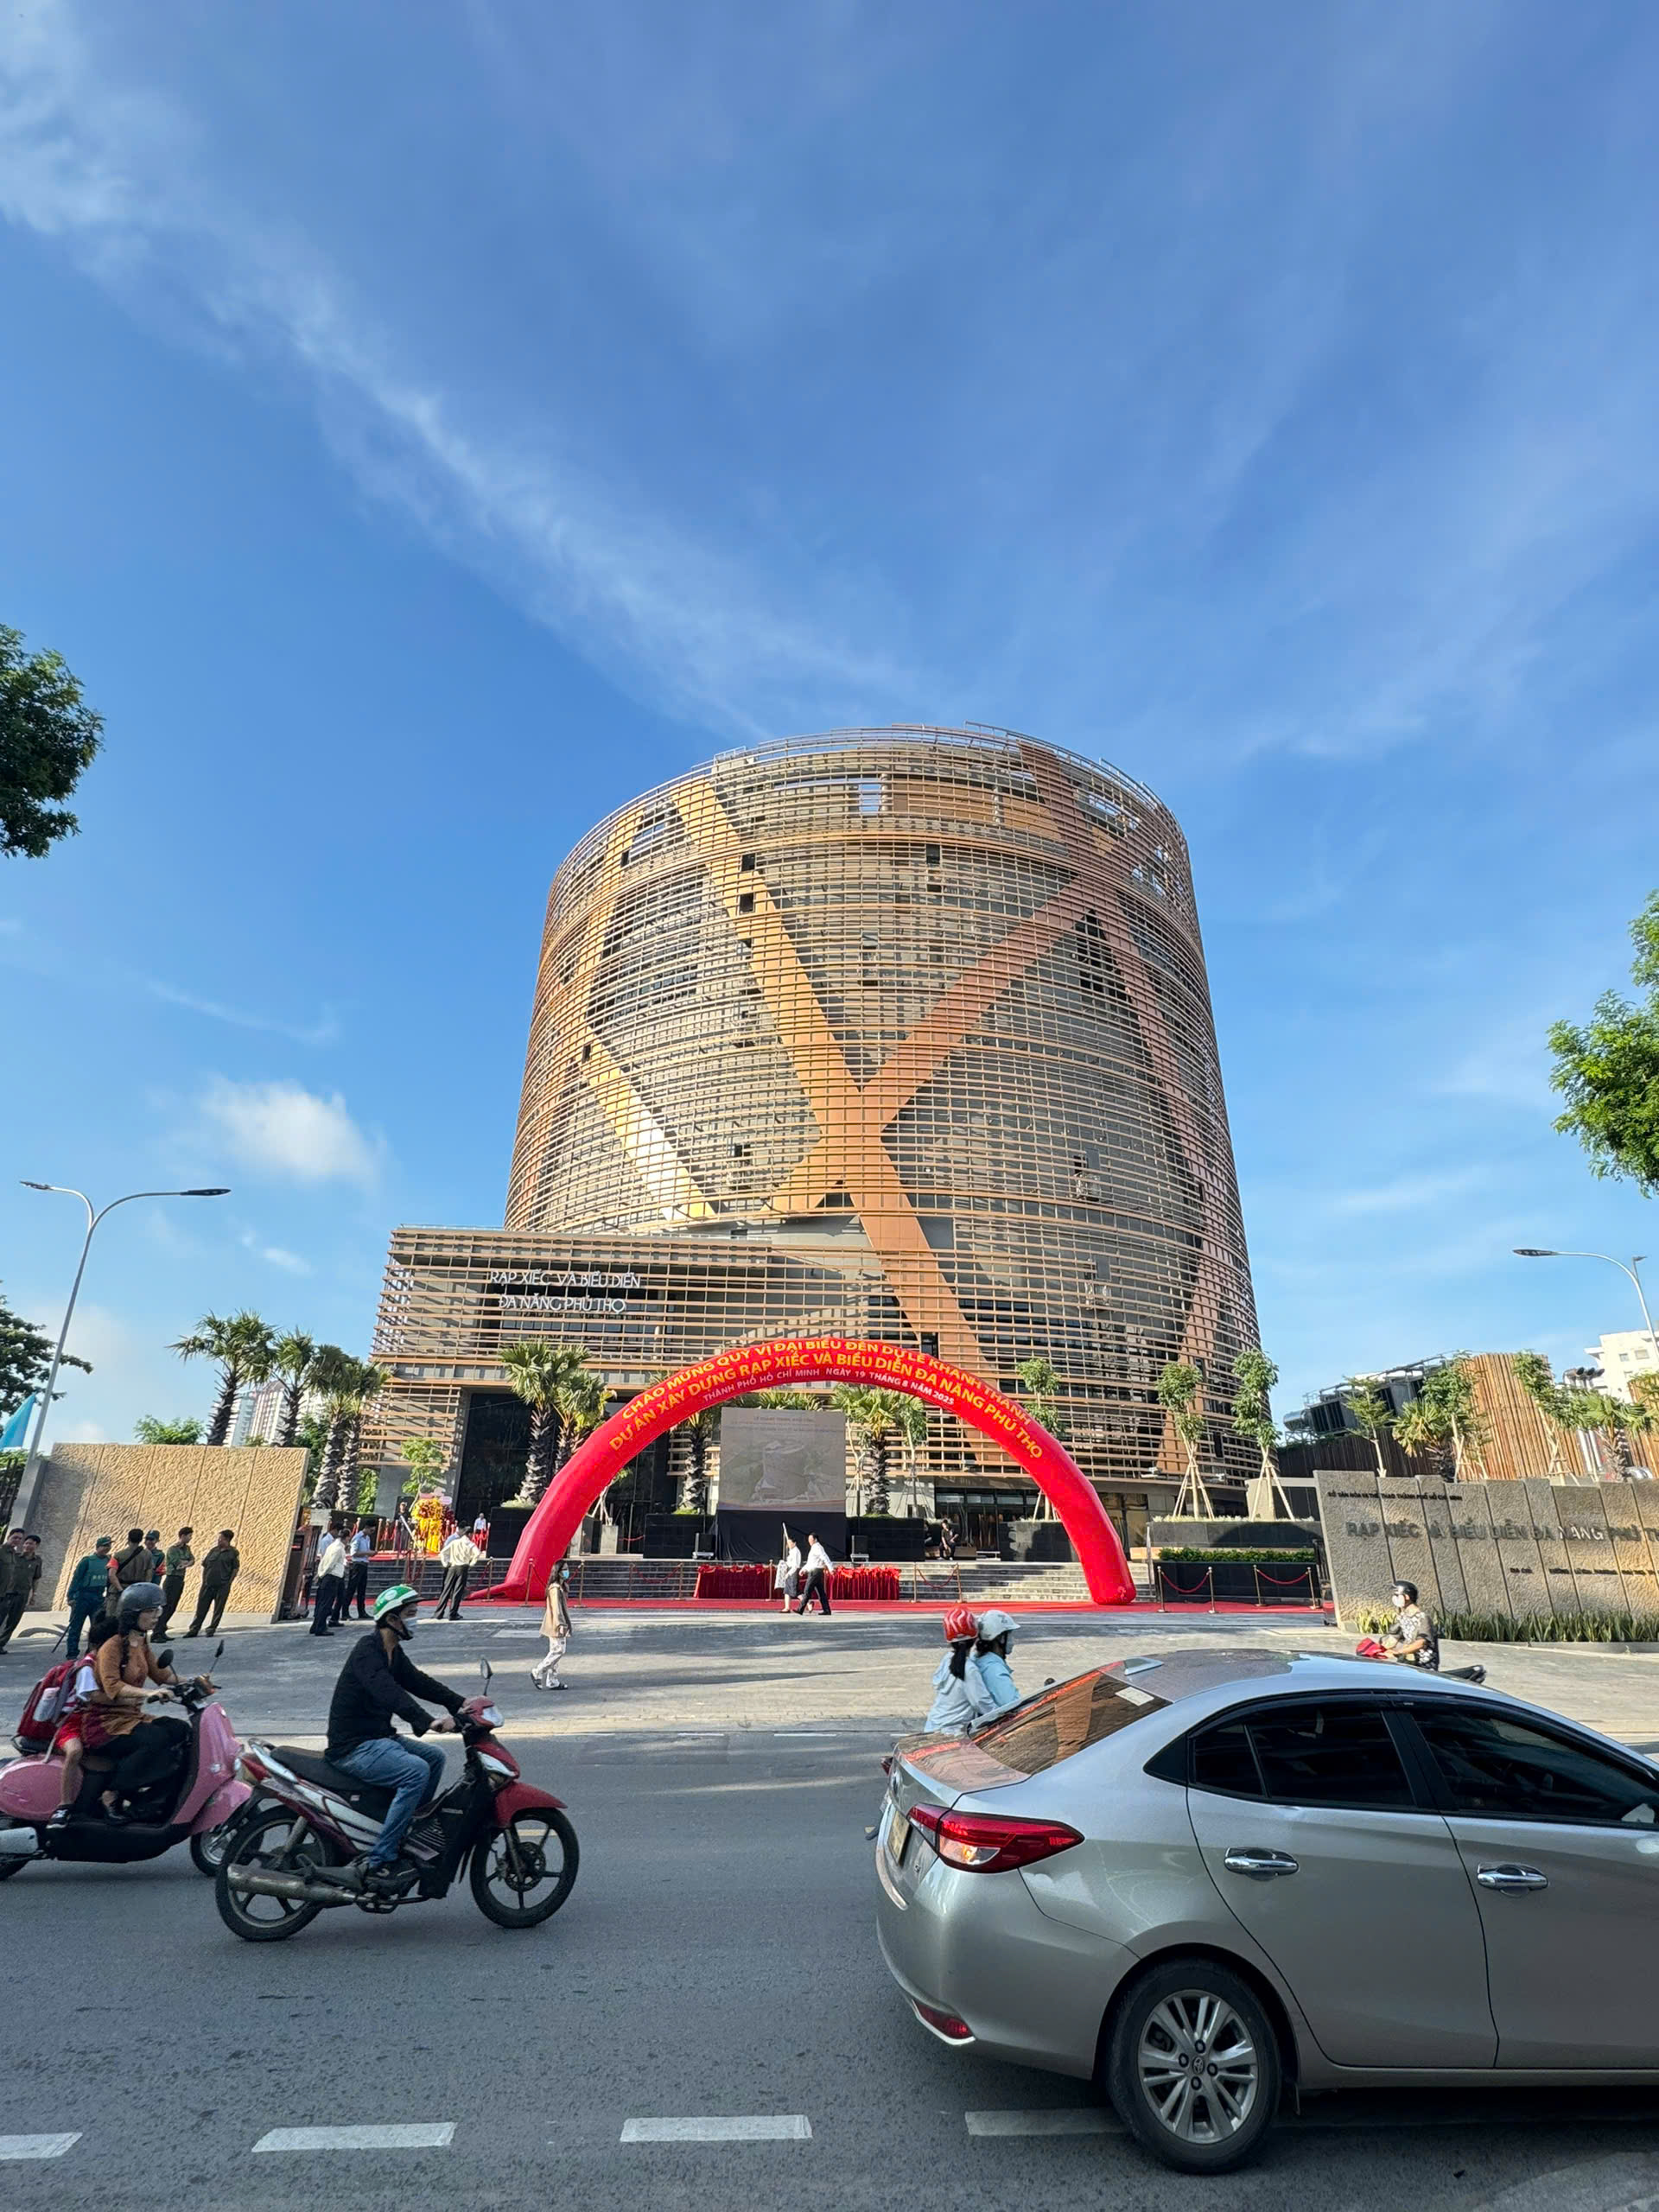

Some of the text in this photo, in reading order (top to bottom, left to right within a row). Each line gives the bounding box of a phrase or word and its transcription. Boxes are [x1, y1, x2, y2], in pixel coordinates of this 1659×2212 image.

[490, 1270, 518, 1287] RẠP
[498, 1294, 518, 1309] ĐA
[519, 1292, 563, 1311] NĂNG
[795, 1368, 820, 1377] MINH
[855, 1370, 867, 1378] 19
[868, 1371, 901, 1386] THÁNG
[932, 1389, 955, 1406] 2025
[687, 1368, 736, 1396] DỰNG
[739, 1359, 772, 1376] RẠP
[774, 1351, 810, 1368] XIẾC
[813, 1351, 833, 1365] VÀ
[915, 1368, 938, 1386] ĐA
[939, 1377, 986, 1408] NĂNG
[984, 1403, 1017, 1432] PHÚ
[1016, 1427, 1043, 1459] THỌ
